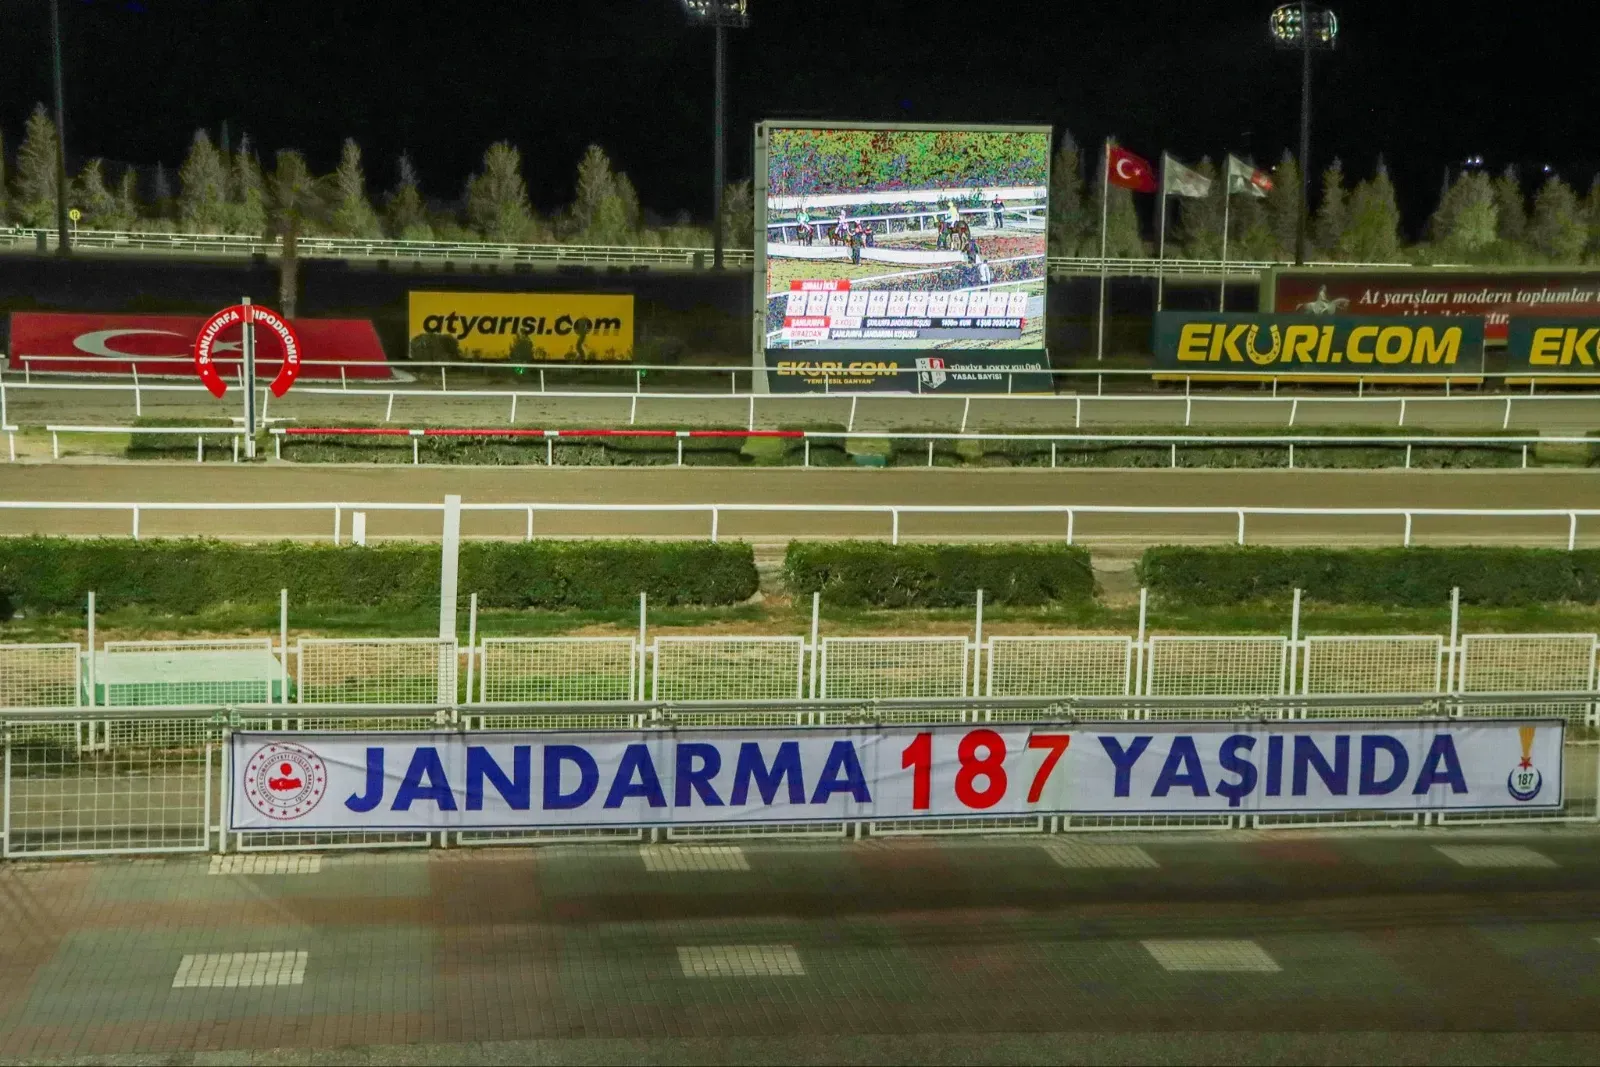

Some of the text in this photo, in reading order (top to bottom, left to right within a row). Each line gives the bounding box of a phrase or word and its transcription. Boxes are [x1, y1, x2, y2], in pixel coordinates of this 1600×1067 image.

[1359, 288, 1379, 305] At
[1381, 289, 1448, 308] yarışları
[1452, 288, 1512, 304] modern
[1516, 288, 1595, 307] toplumlar
[344, 729, 1469, 813] JANDARMA 187 YAŞINDA
[1517, 772, 1534, 786] 187
